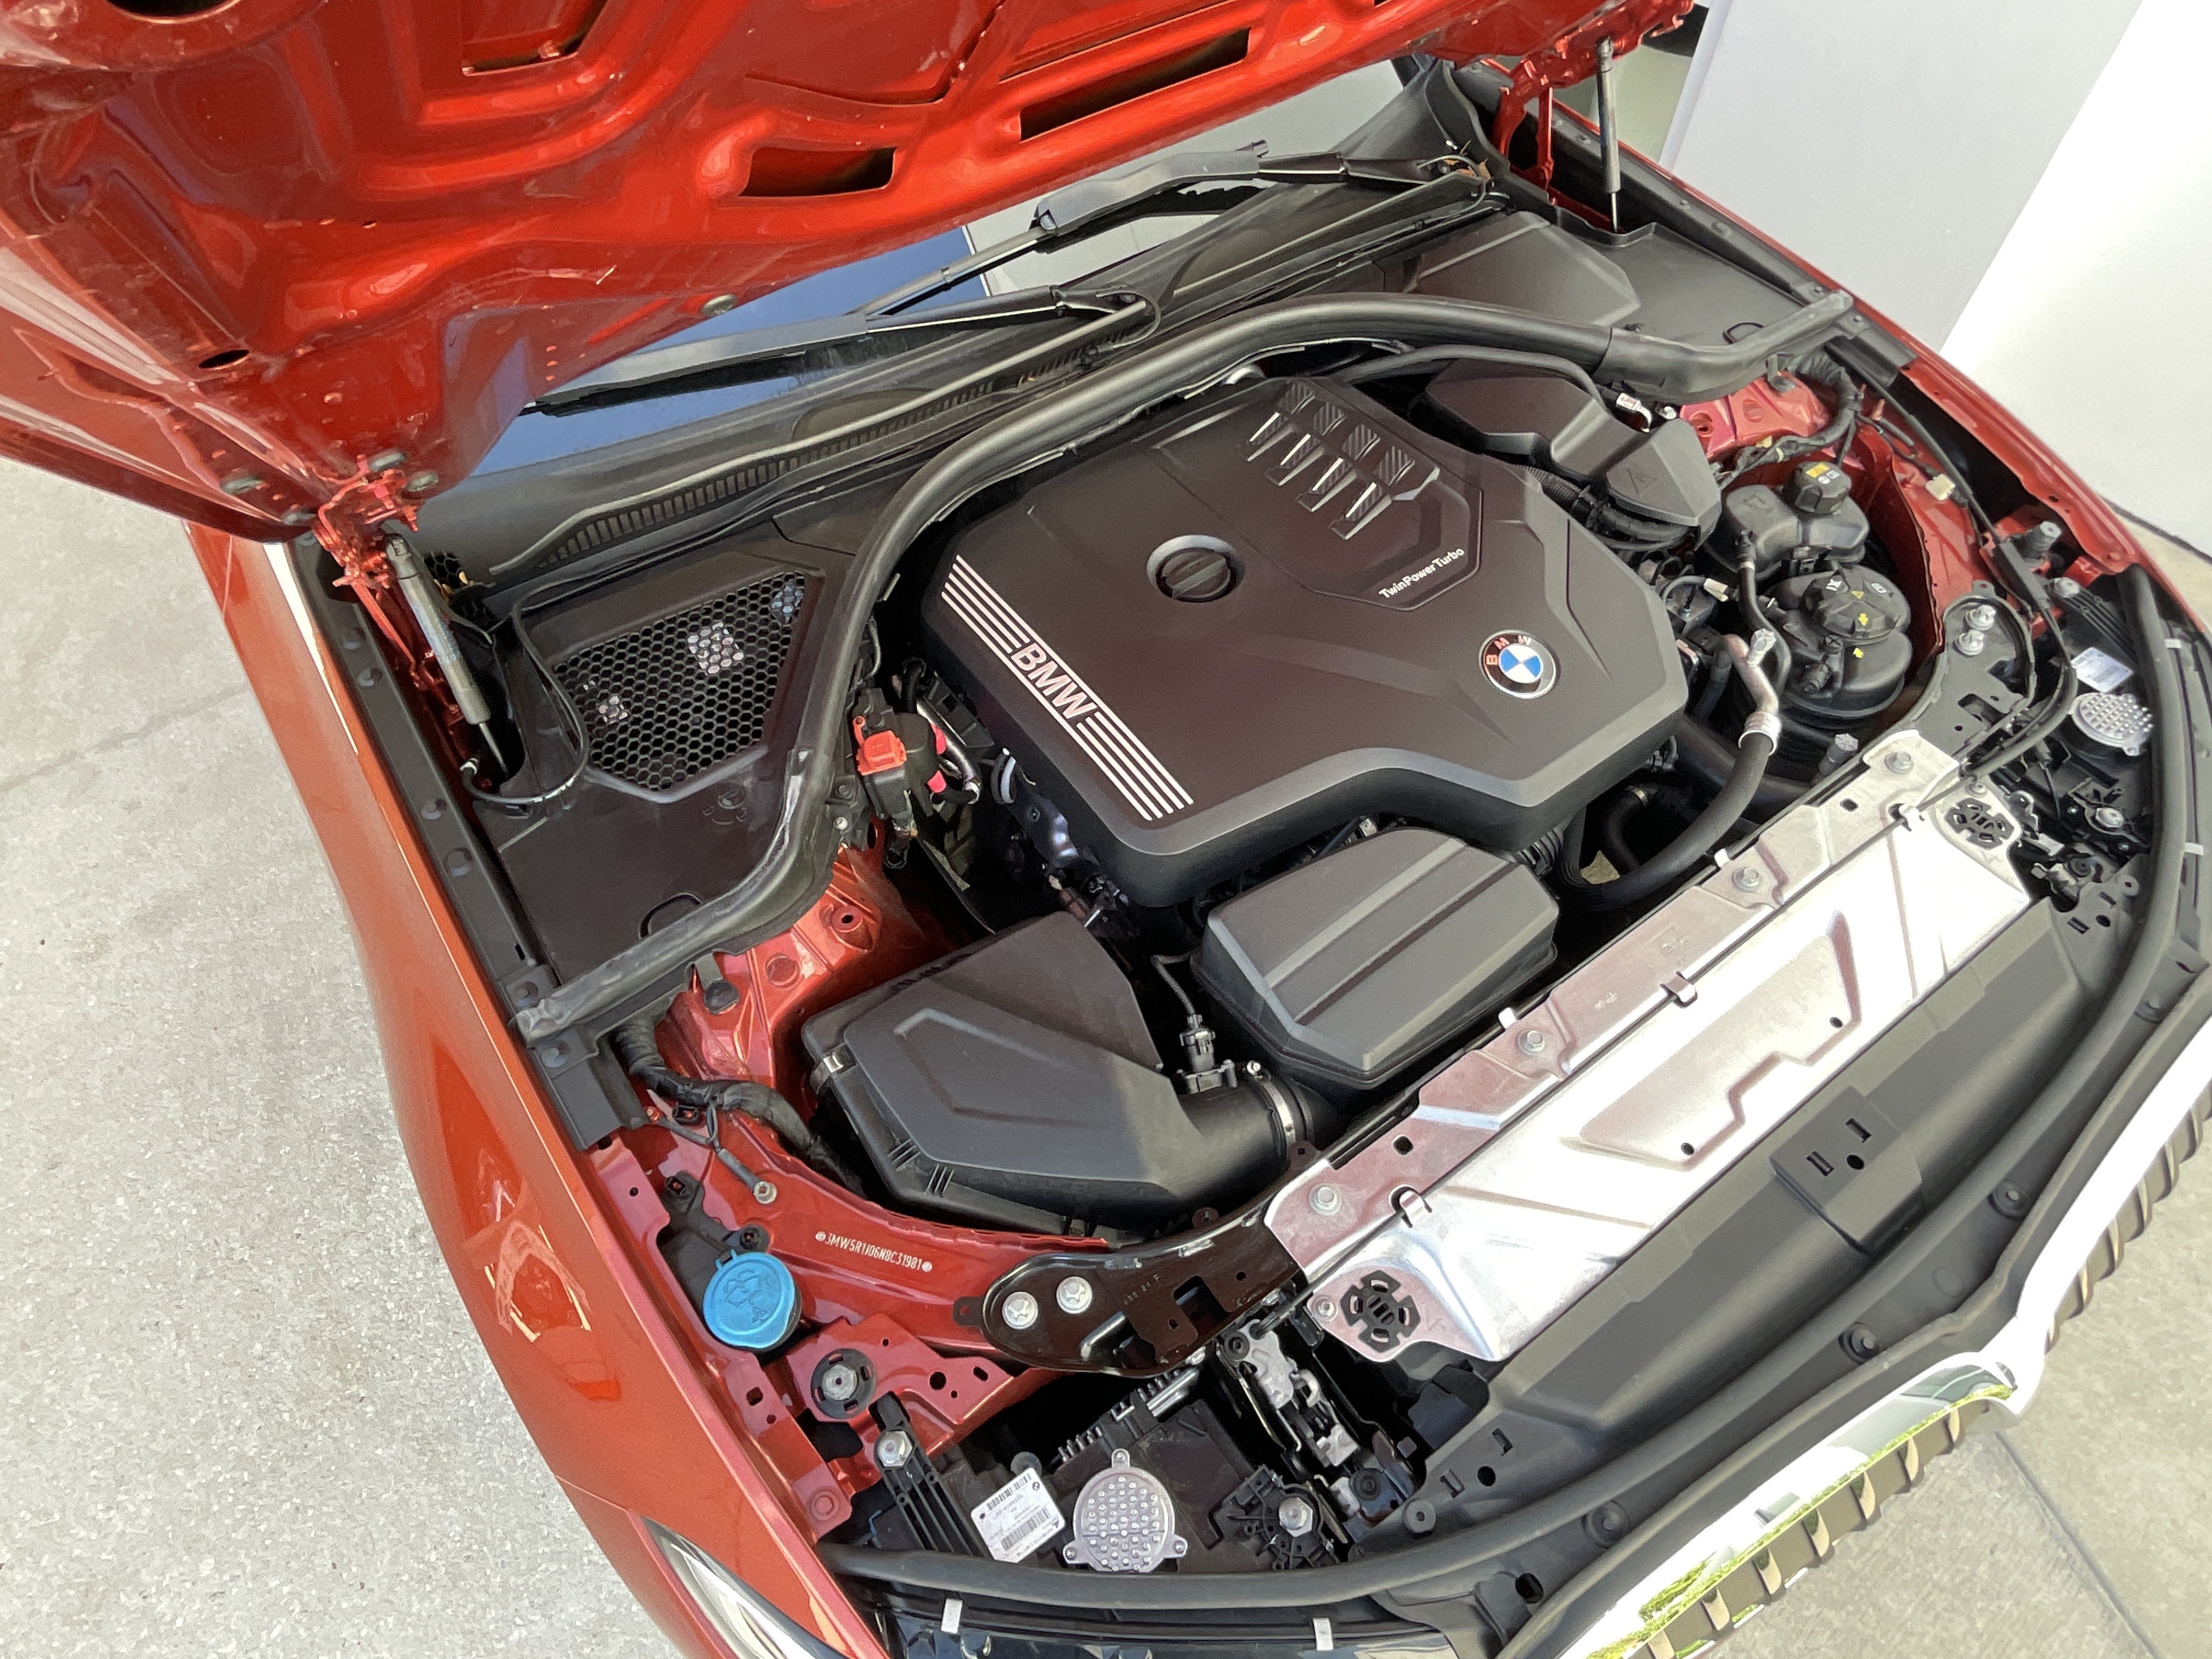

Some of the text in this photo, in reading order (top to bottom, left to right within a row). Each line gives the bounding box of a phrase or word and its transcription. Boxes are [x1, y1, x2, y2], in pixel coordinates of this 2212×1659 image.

[1378, 548, 1465, 599] TwinPowerTurbo
[1486, 635, 1532, 665] BMW
[1011, 642, 1098, 720] BMW
